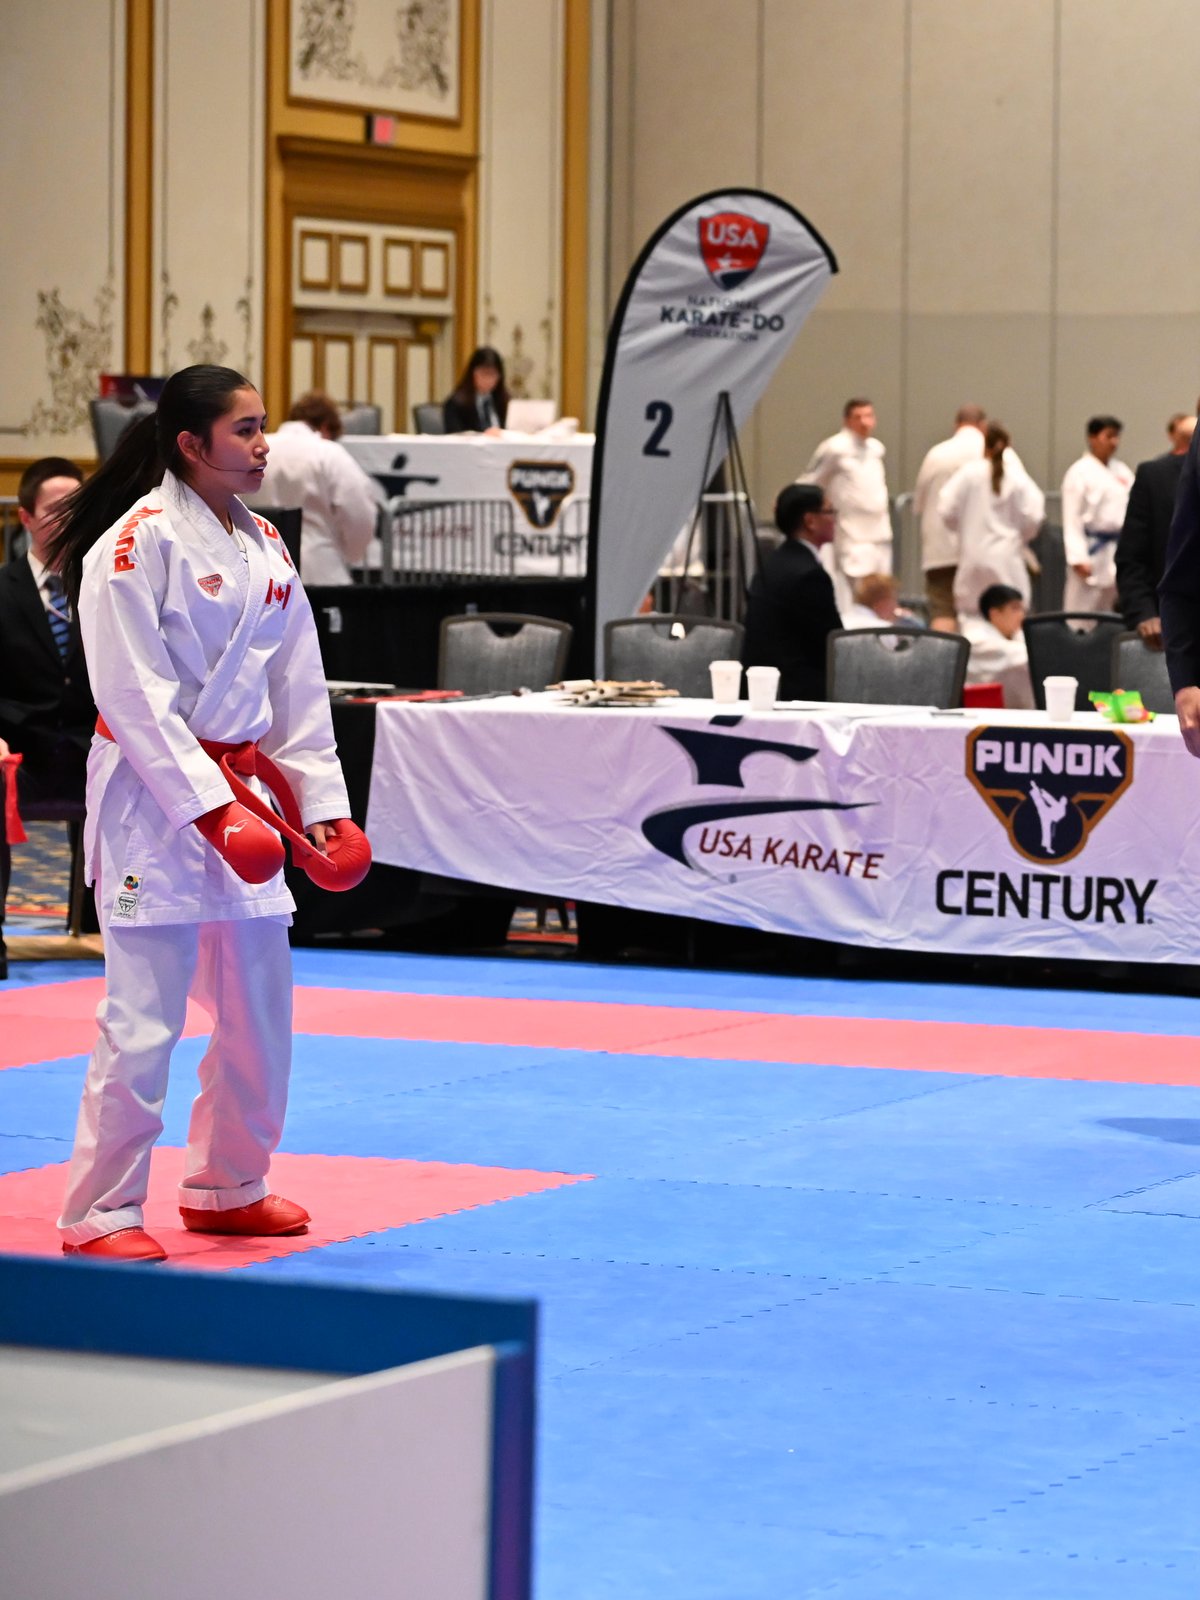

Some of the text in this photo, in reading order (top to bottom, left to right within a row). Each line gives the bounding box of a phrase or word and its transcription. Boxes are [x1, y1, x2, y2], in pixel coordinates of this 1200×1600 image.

[706, 221, 759, 249] USA
[659, 305, 785, 333] KARATE-DO
[642, 400, 674, 458] 2
[114, 506, 164, 573] PUNOK
[976, 739, 1123, 778] PUNOK
[699, 827, 885, 880] USA KARATE
